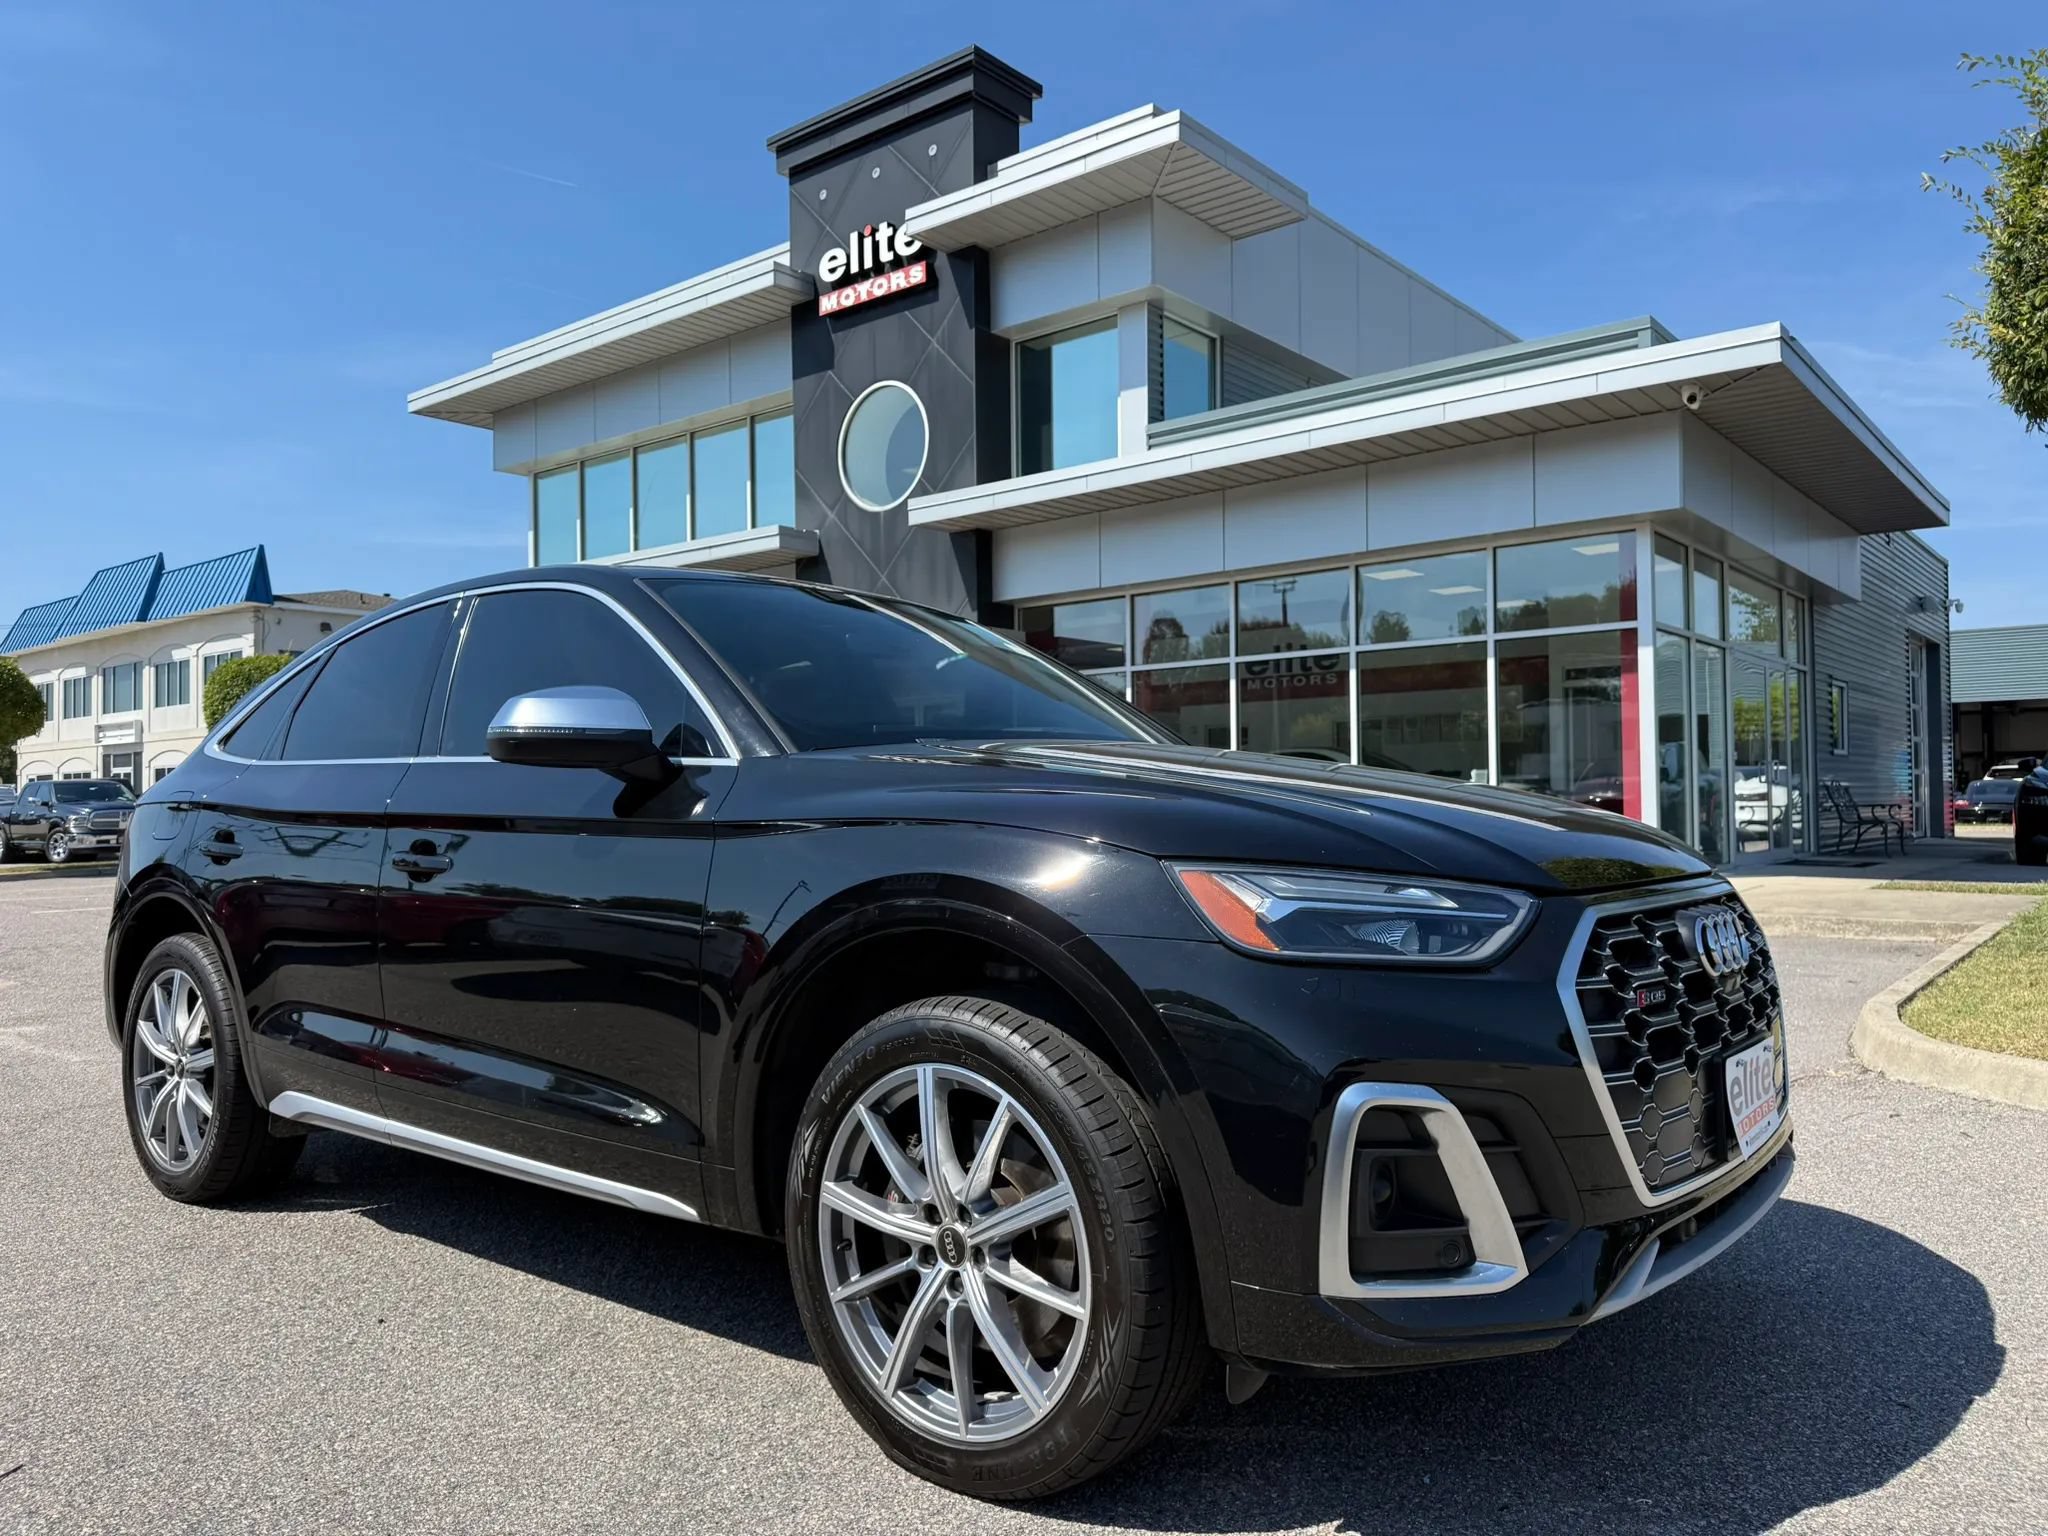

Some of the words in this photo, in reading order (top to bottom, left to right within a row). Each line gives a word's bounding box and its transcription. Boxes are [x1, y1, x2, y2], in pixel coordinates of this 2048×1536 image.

[818, 221, 923, 283] elite
[820, 264, 925, 313] MOTORS
[1245, 642, 1340, 675] elite
[1247, 673, 1338, 690] MOTORS
[820, 1045, 877, 1105] VIENTO
[1729, 1055, 1772, 1117] elite
